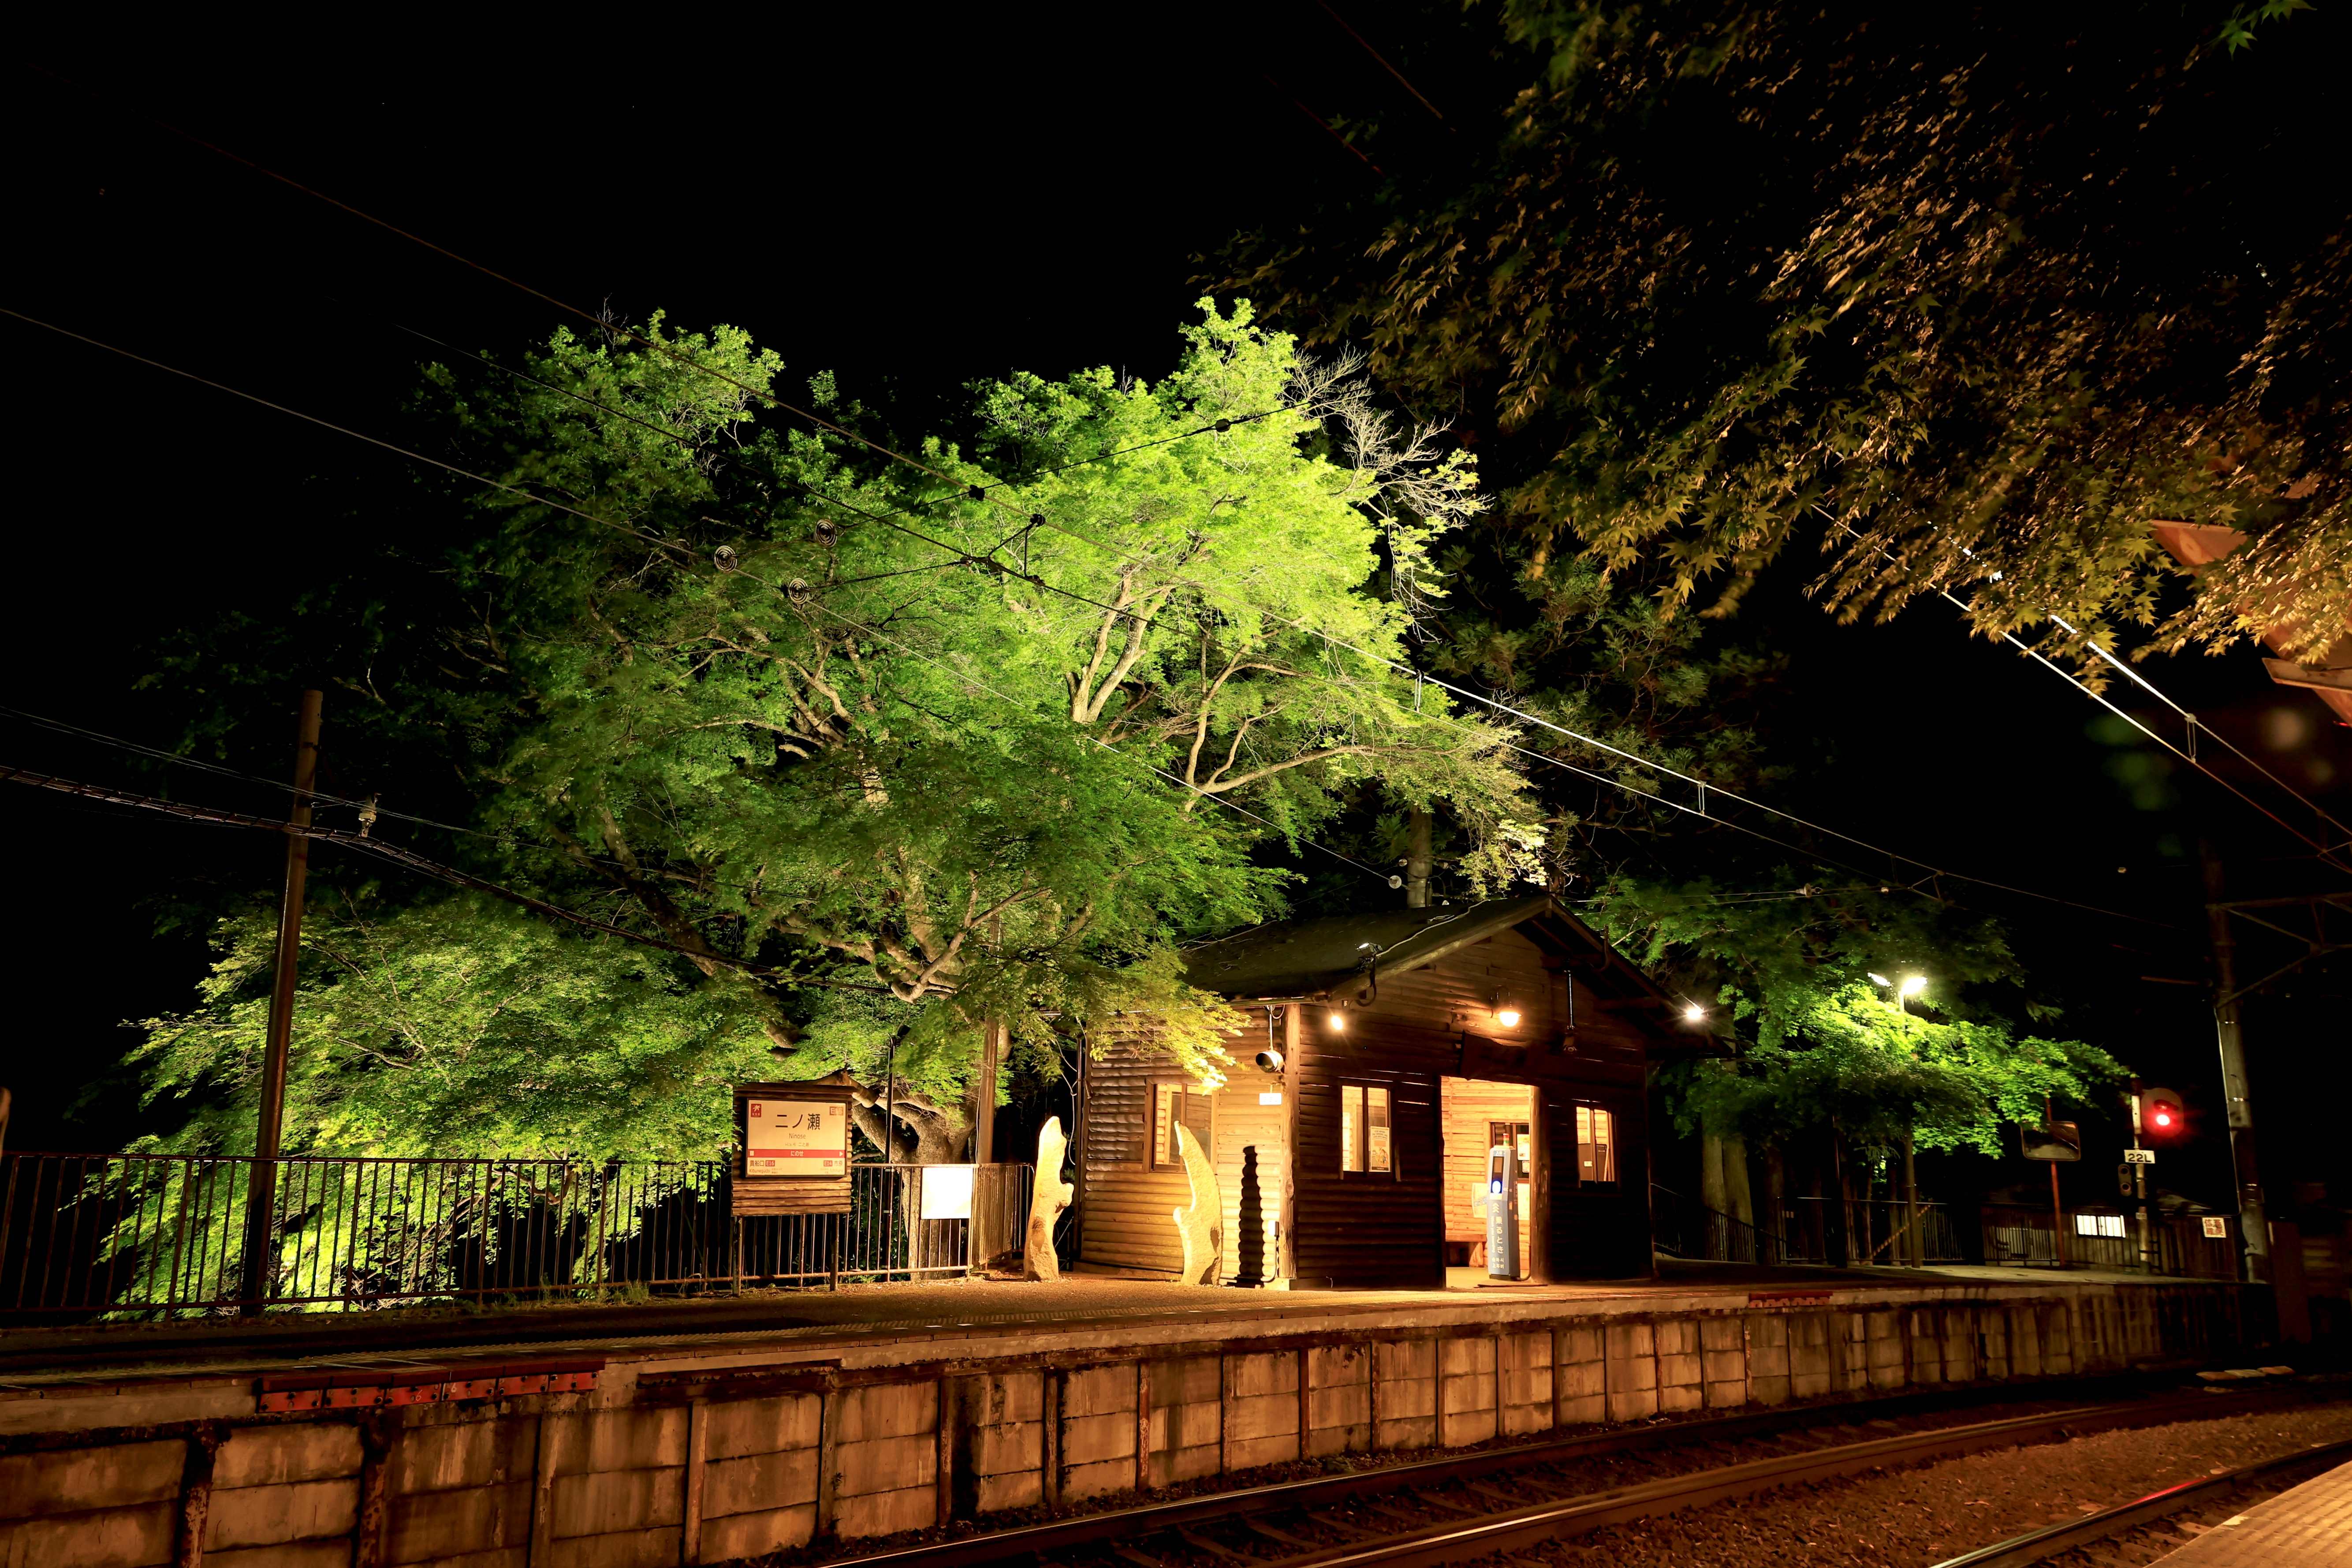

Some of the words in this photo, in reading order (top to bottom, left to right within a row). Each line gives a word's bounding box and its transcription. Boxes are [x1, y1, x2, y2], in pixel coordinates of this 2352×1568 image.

[775, 1113, 820, 1130] 二ノ瀬
[2128, 1153, 2151, 1162] 22L
[416, 1389, 423, 1401] 6
